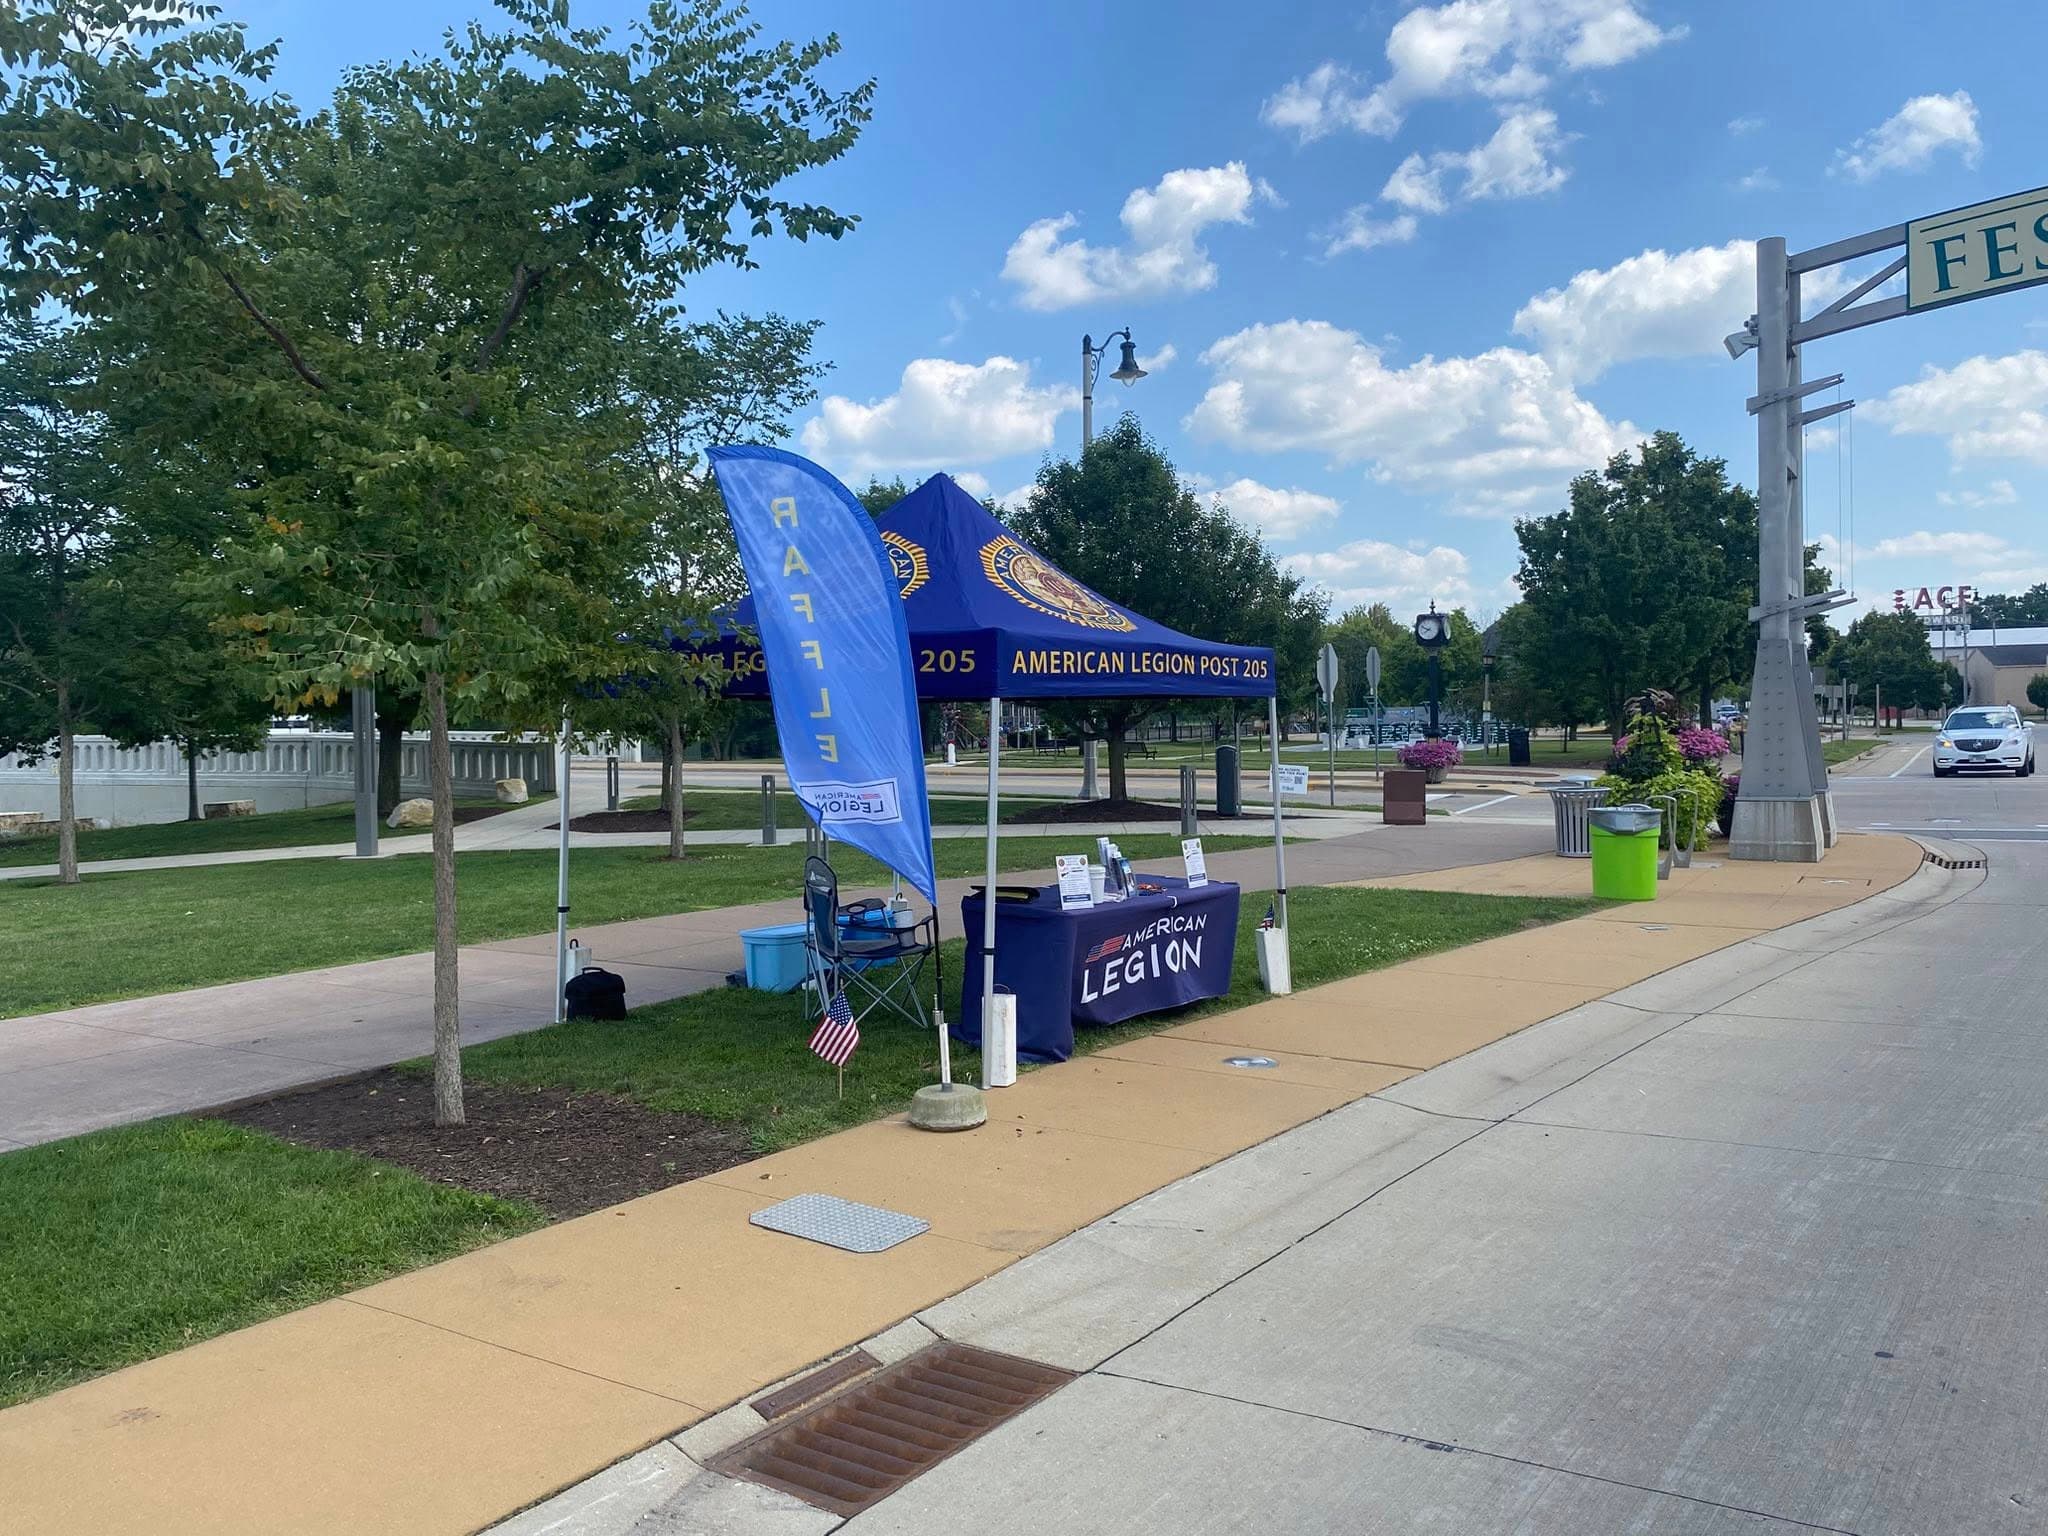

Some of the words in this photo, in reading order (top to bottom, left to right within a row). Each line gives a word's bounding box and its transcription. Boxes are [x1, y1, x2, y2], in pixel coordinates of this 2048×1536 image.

[1913, 585, 1971, 609] ACE
[919, 650, 976, 673] 205
[1012, 650, 1124, 674] AMERICAN
[1132, 652, 1195, 675] LEGION
[1201, 656, 1239, 677] POST
[1243, 658, 1268, 679] 205
[1121, 914, 1207, 951] AMERICAN
[1080, 936, 1202, 1004] LEGION
